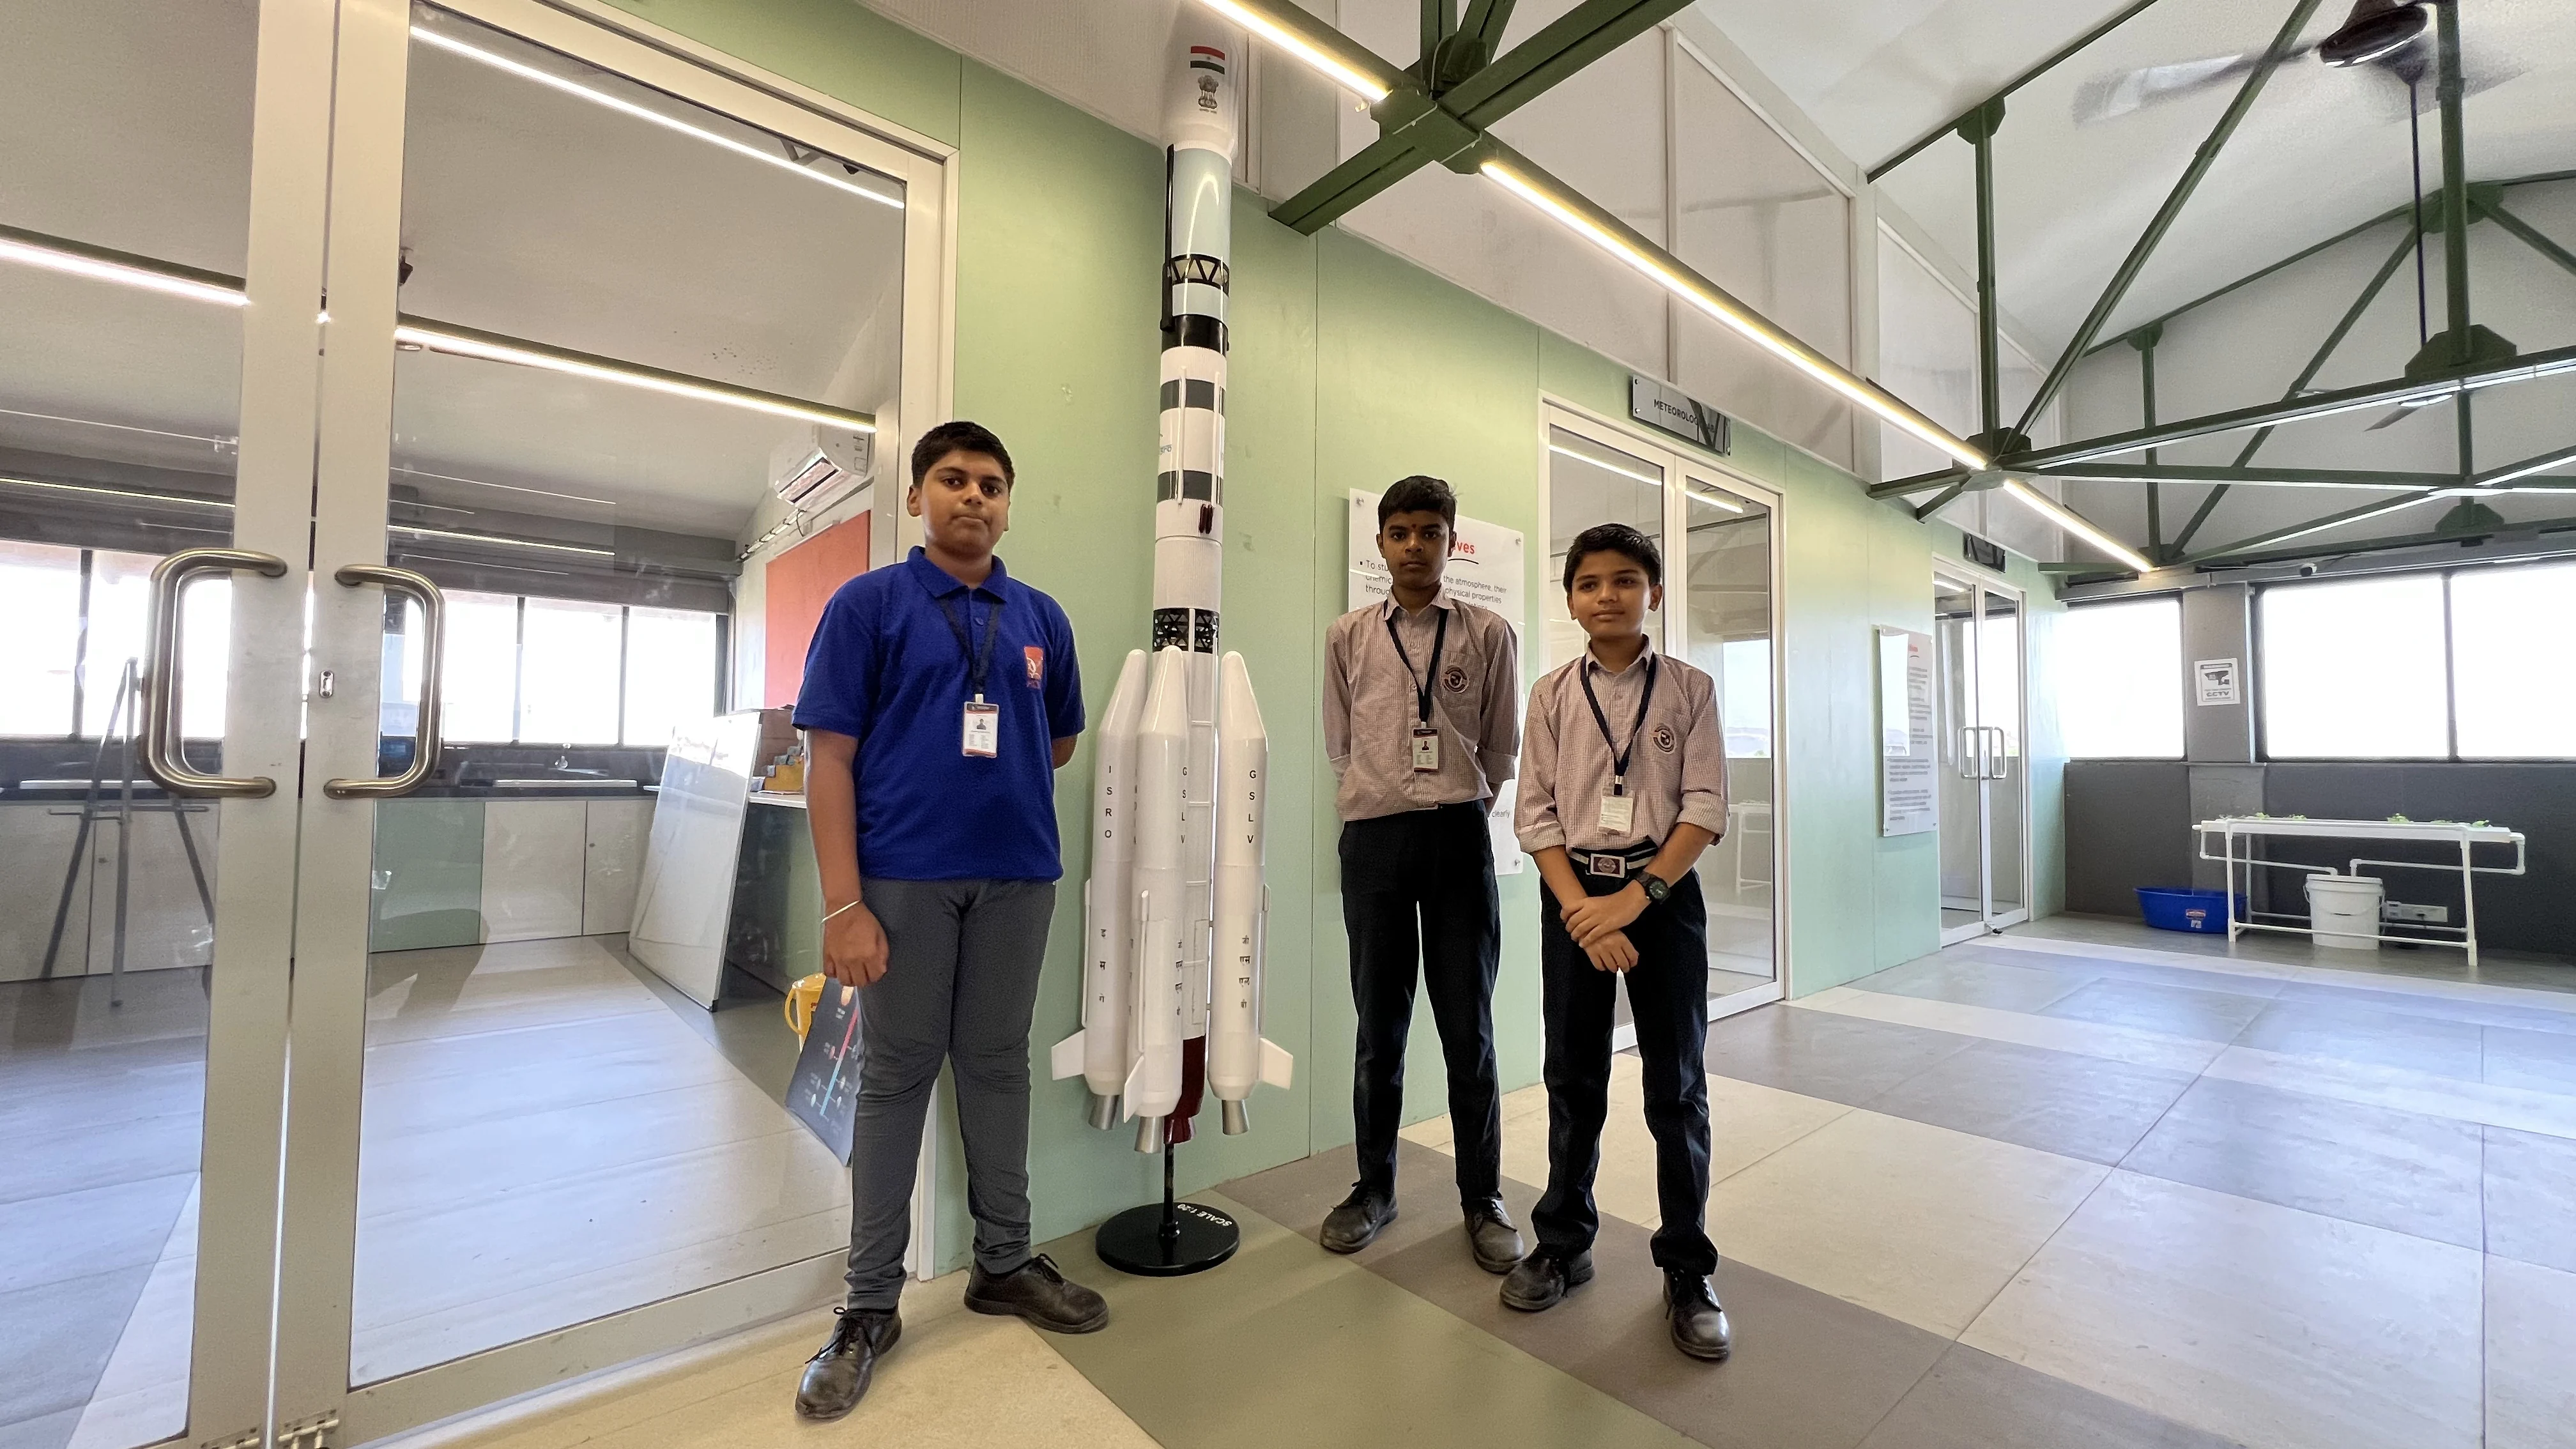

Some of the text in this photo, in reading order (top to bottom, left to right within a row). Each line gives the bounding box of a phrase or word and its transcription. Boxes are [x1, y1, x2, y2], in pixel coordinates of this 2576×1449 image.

[1654, 399, 1698, 425] METEOROLOG
[1365, 575, 1392, 584] chemic
[1366, 560, 1376, 570] To
[1377, 564, 1389, 572] stu
[1443, 575, 1454, 584] the
[1104, 765, 1113, 838] ISRO
[1247, 770, 1257, 844] GSLV
[1197, 1211, 1232, 1226] SCALE
